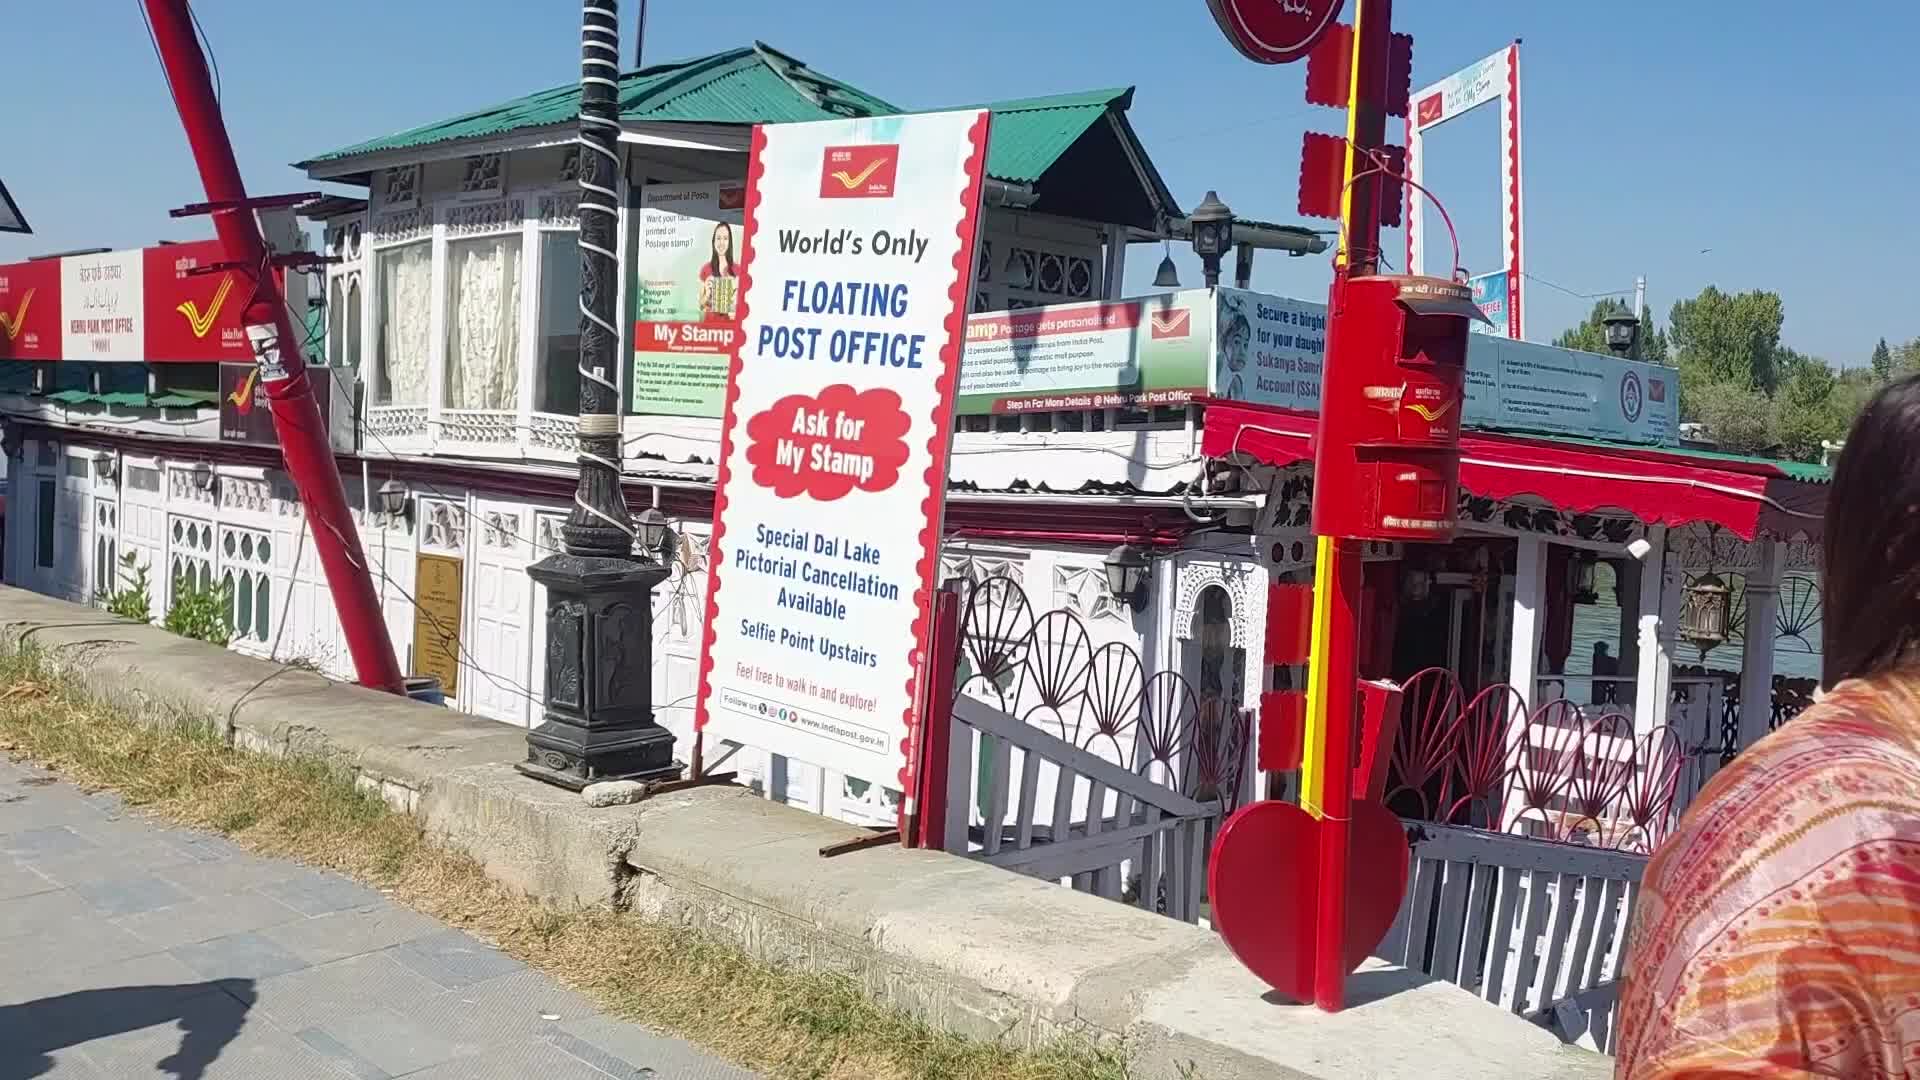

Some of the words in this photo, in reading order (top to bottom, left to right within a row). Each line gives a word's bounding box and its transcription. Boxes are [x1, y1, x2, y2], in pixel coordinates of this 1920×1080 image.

[646, 239, 669, 248] Postage
[778, 228, 862, 255] World's
[872, 228, 928, 264] Only
[782, 280, 908, 318] FLOATING
[1257, 303, 1290, 323] Secure
[1292, 313, 1297, 324] a
[101, 318, 114, 334] POST
[114, 317, 133, 333] OFFICE
[654, 324, 678, 344] My
[682, 324, 734, 346] Stamp
[966, 322, 998, 340] amp
[1036, 320, 1056, 334] gets
[1256, 328, 1270, 344] for
[1273, 334, 1293, 348] your
[758, 325, 822, 360] POST
[830, 329, 926, 368] OFFICE
[1256, 352, 1296, 373] Sukanya
[1007, 400, 1023, 410] Step
[1024, 399, 1031, 408] In
[1032, 398, 1044, 408] For
[1044, 398, 1064, 408] More
[1065, 396, 1091, 407] Details
[1094, 396, 1102, 406] @
[1104, 394, 1128, 404] Nehru
[1130, 392, 1146, 403] Park
[1149, 392, 1166, 402] Post
[1256, 376, 1295, 393] Account
[792, 407, 830, 437] Ask
[834, 410, 865, 440] for
[776, 438, 804, 474] My
[810, 442, 874, 484] Stamp
[756, 523, 809, 552] Special
[814, 533, 838, 557] Dal
[844, 539, 880, 565] Lake
[736, 548, 797, 579] Pictorial
[802, 562, 899, 600] Cancellation
[776, 586, 846, 620] Available
[740, 619, 776, 643] Selfie
[780, 628, 814, 652] Point
[819, 636, 878, 668] Upstairs
[736, 662, 753, 680] Feel
[755, 666, 772, 686] free
[775, 671, 784, 688] to
[786, 675, 806, 694] walk
[809, 680, 818, 697] in
[820, 684, 838, 704] and
[840, 691, 877, 712] explore!
[724, 694, 748, 708] Follow
[749, 702, 758, 711] us
[800, 717, 884, 748] www.indiapost.gov.in
